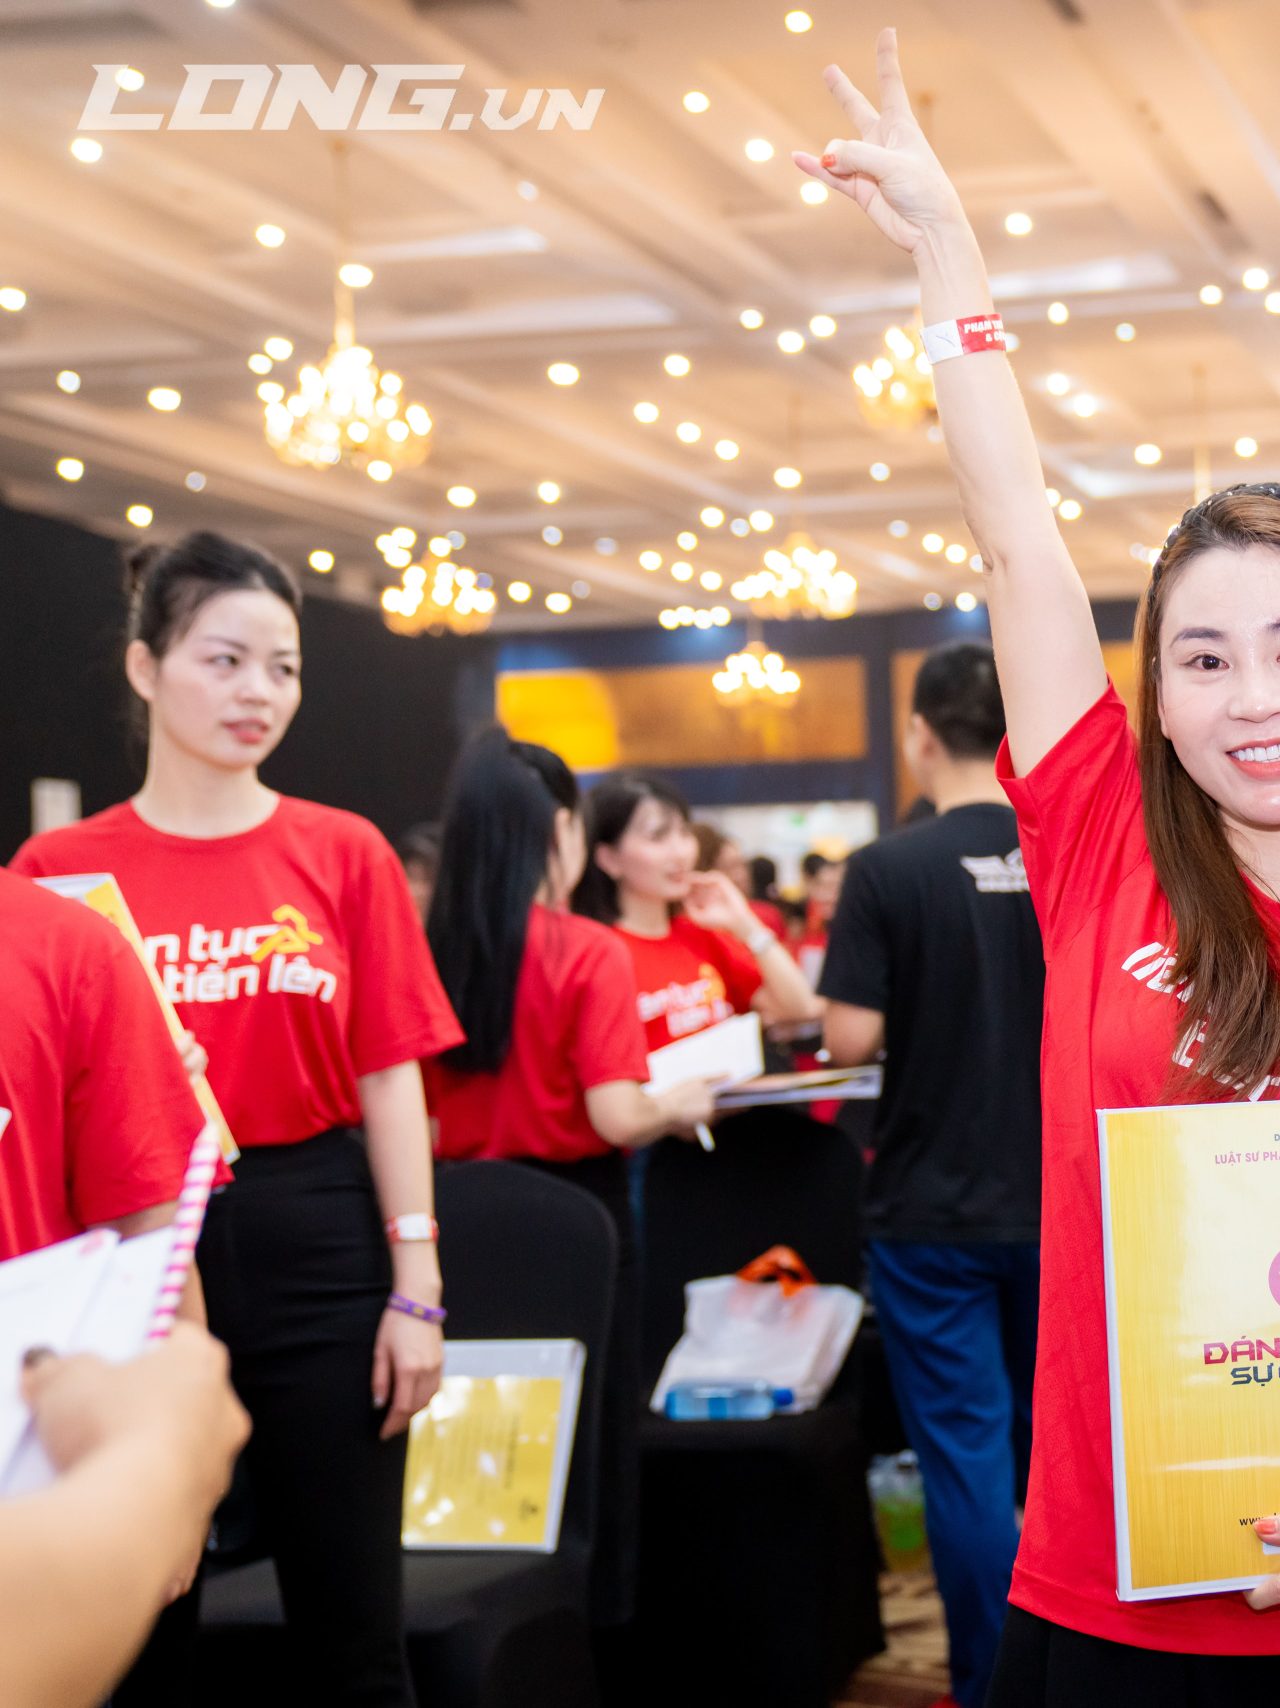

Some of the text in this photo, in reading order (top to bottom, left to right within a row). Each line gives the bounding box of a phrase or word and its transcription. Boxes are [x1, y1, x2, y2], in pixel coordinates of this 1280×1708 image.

[267, 953, 337, 1003] lên
[1214, 1151, 1242, 1166] LUẬT
[1245, 1151, 1260, 1163] SƯ
[1230, 1362, 1274, 1387] SỰ
